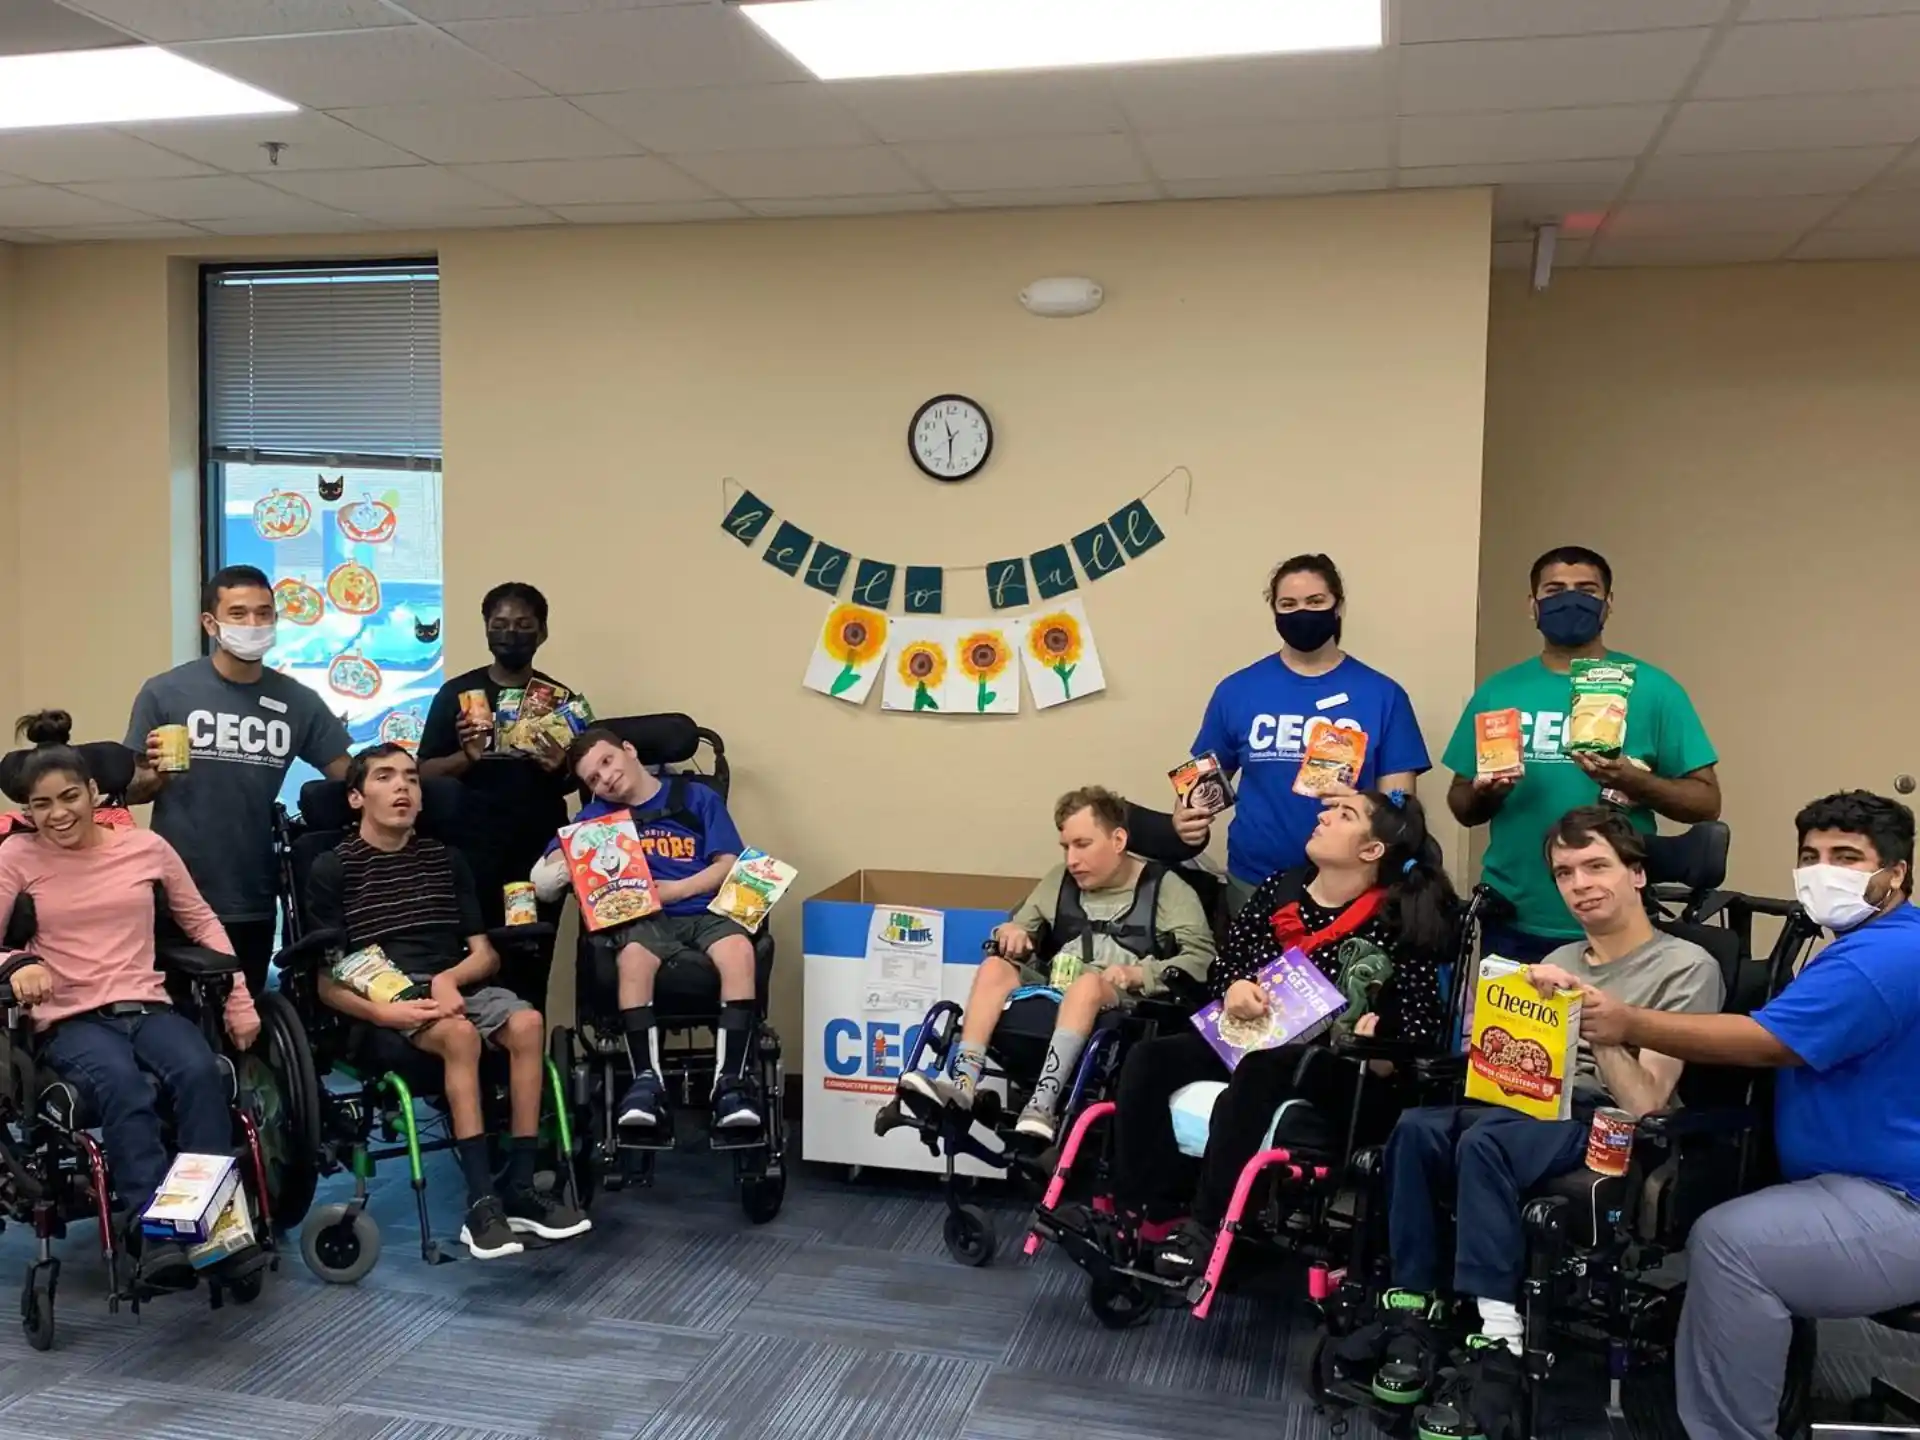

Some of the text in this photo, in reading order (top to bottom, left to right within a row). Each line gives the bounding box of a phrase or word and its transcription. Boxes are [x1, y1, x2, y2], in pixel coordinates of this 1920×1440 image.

[934, 409, 942, 419] 11
[946, 405, 958, 415] 12
[924, 420, 936, 431] 10
[187, 709, 291, 757] CECO
[640, 837, 696, 857] TORS
[1486, 983, 1560, 1028] Cheerios
